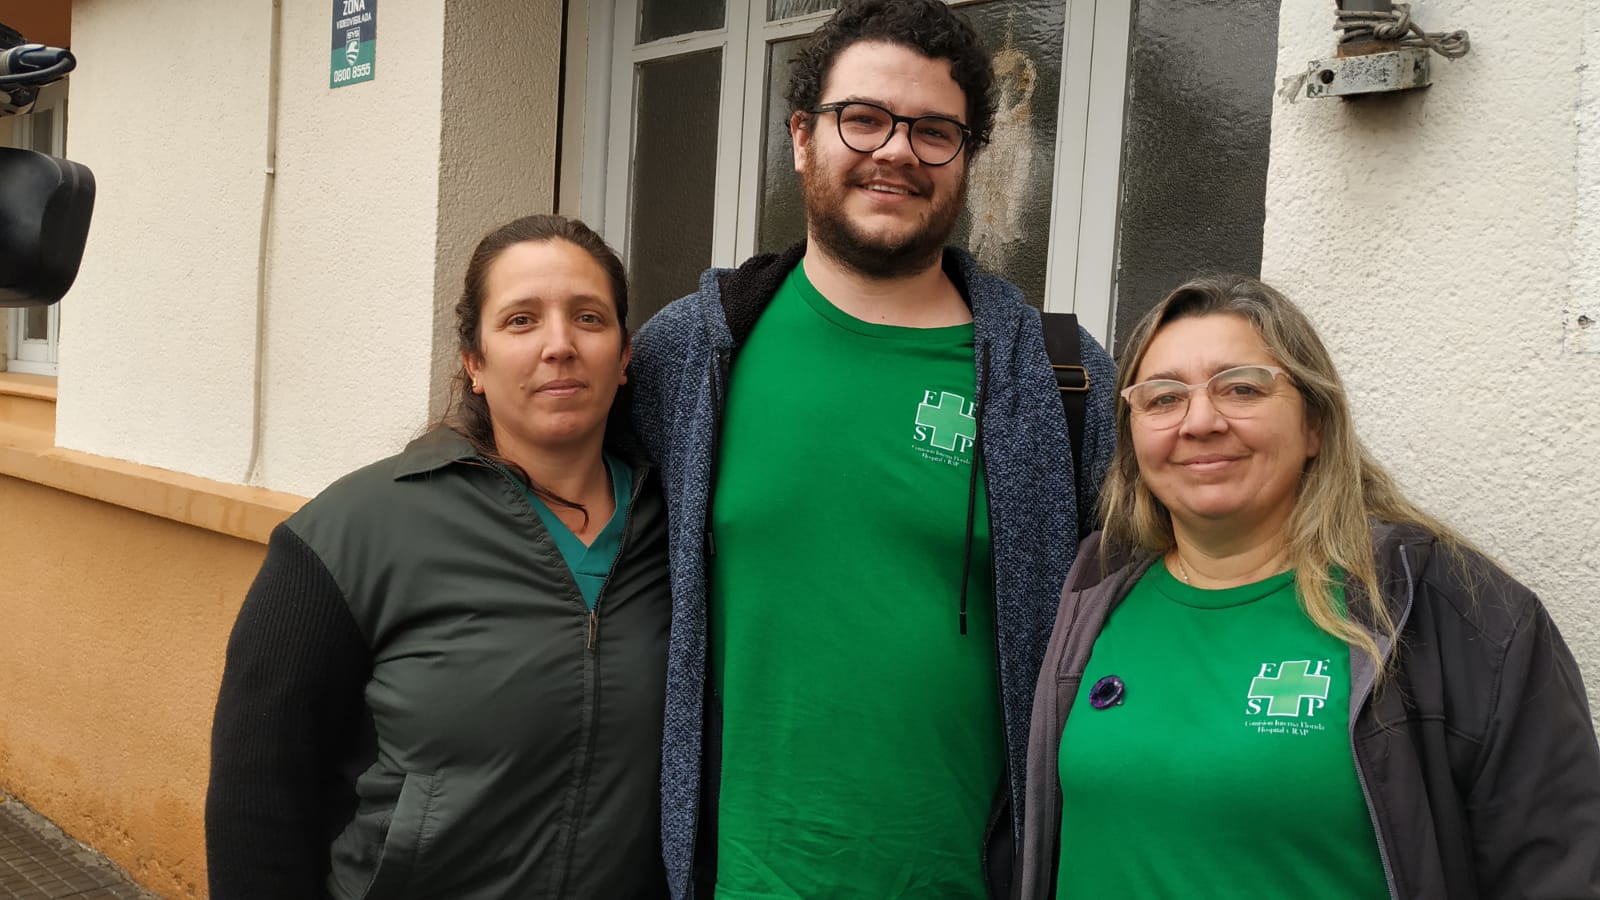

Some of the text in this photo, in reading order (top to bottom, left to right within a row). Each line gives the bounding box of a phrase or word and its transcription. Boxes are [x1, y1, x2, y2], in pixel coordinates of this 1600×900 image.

[343, 0, 366, 16] ZONA
[334, 63, 371, 82] 0800 8555
[923, 390, 937, 405] F
[913, 426, 974, 453] S P
[1258, 659, 1330, 677] F F
[1246, 698, 1325, 716] S P
